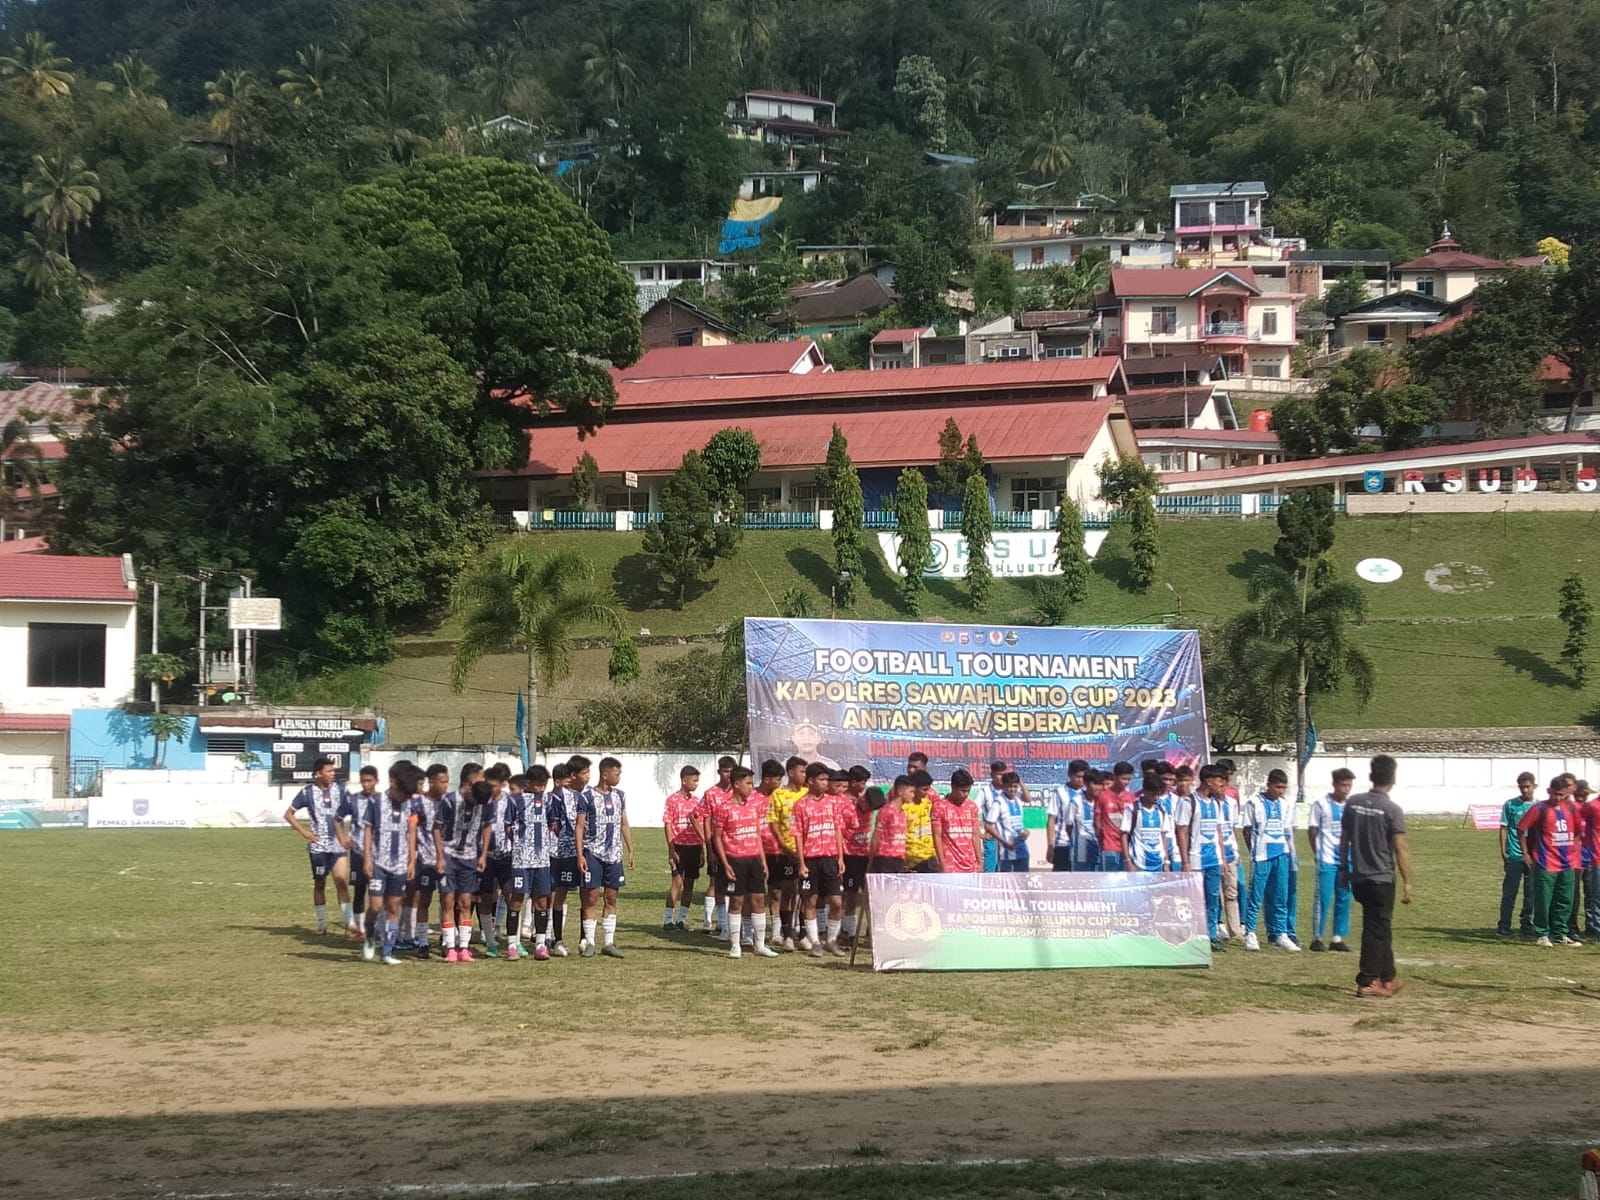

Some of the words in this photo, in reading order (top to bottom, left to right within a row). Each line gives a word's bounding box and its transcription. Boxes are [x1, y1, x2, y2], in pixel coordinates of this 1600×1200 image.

[1403, 468, 1538, 493] RSUD
[814, 649, 953, 676] FOOTBALL
[958, 652, 1138, 679] TOURNAMENT
[775, 680, 901, 704] KAPOLRES
[905, 682, 1067, 707] SAWAHLUNTO
[1072, 687, 1118, 707] CUP
[1123, 687, 1177, 708] 2023
[275, 719, 316, 729] LAPANGAN
[842, 707, 923, 731] ANTAR
[928, 708, 1119, 735] SMA/SEDERAJAT
[967, 741, 991, 759] HUT
[995, 742, 1026, 759] KOTA
[1028, 742, 1109, 760] SAWAHLUNTO
[1555, 819, 1567, 832] 16
[514, 877, 523, 888] 15
[561, 872, 573, 882] 26
[802, 880, 812, 890] 16
[963, 899, 1027, 912] FOOTBALL
[1031, 900, 1118, 913] TOURNAMENT
[948, 913, 1008, 924] KAPOLRES
[1008, 914, 1085, 927] SAWAHLUNTO
[1088, 916, 1111, 926] CUP
[1113, 916, 1140, 927] 2023
